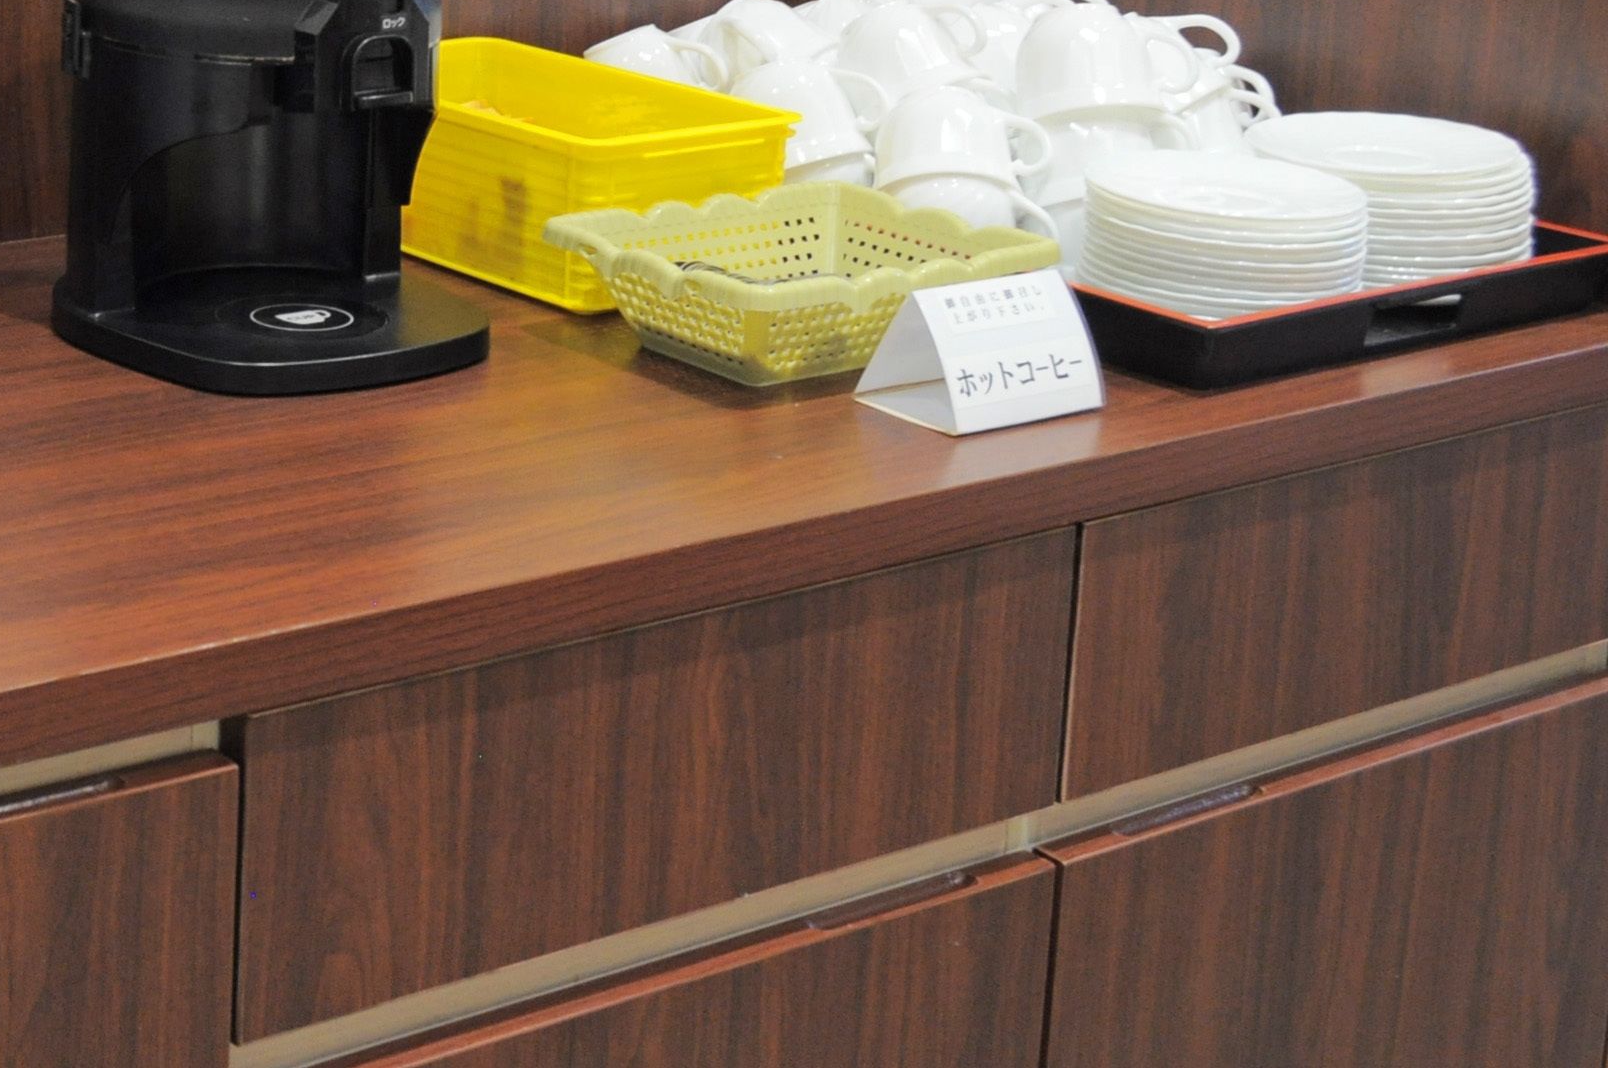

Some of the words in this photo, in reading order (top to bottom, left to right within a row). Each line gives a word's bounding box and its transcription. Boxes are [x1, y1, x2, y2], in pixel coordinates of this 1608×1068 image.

[382, 16, 406, 29] ロック
[956, 354, 1083, 398] ホットコーヒー
